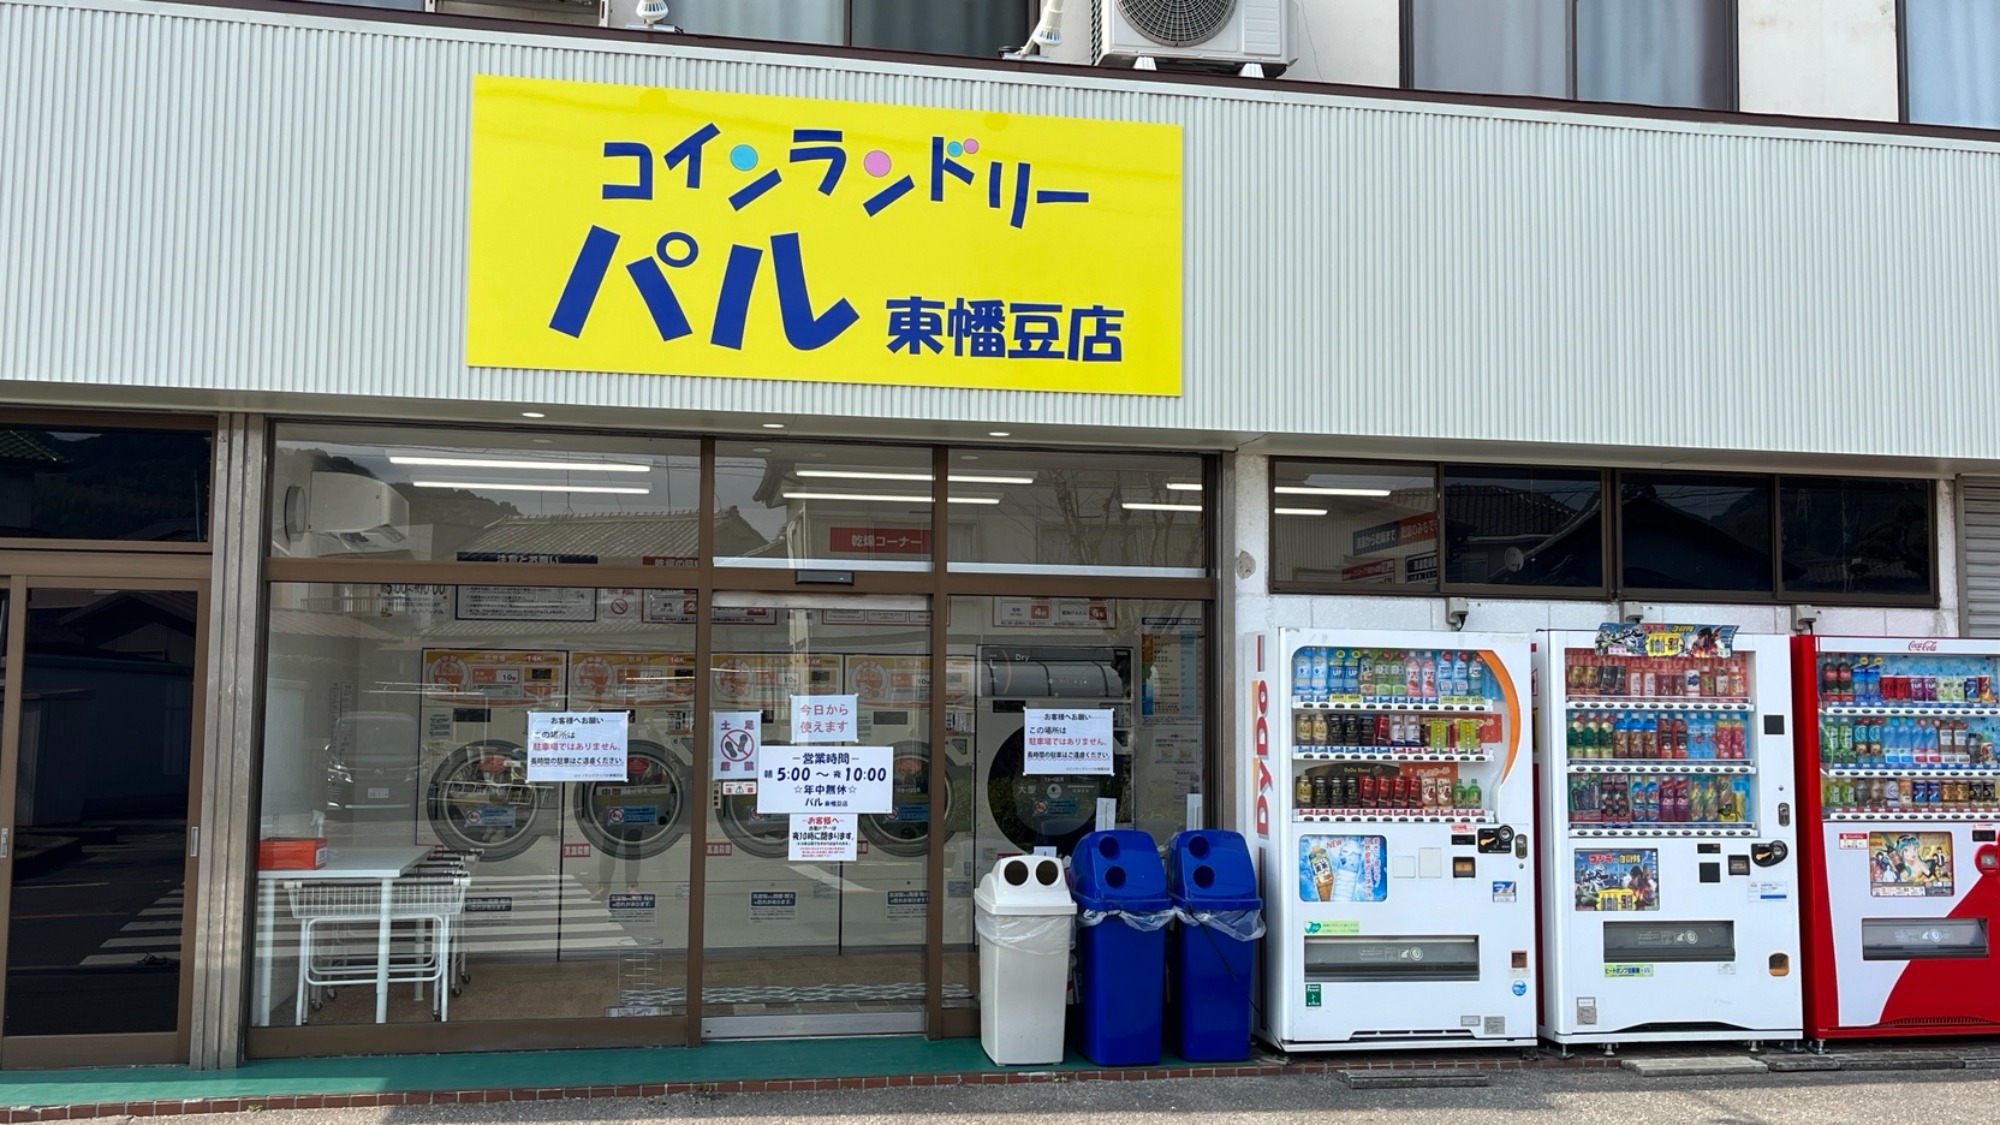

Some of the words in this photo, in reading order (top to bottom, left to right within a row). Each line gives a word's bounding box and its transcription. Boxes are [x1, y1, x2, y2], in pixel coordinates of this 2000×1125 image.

[602, 122, 1090, 229] コインランドリー
[549, 224, 861, 351] パル
[885, 297, 1126, 363] 東幡豆店
[851, 534, 923, 548] 乾燥コーナー
[1015, 653, 1030, 663] Dry
[800, 704, 849, 716] 今日から
[551, 717, 604, 725] お客様へお願い
[1044, 713, 1092, 721] お客様へお願い
[800, 721, 848, 733] 使えます
[1029, 726, 1067, 734] この場所は
[533, 742, 621, 751] 駐車場ではありません。
[1029, 737, 1107, 746] 駐車場ではありません。
[802, 752, 851, 765] 営業時間
[1027, 751, 1110, 759] 長時間の駐車はご遠慮ください。
[1256, 680, 1273, 836] DyDo
[531, 757, 624, 765] 長時間の駐車はご遠慮ください。
[777, 767, 811, 781] 5:00
[845, 767, 887, 781] 10:00
[805, 798, 823, 807] パル
[807, 816, 840, 825] お客様へ
[1326, 839, 1343, 849] NEW
